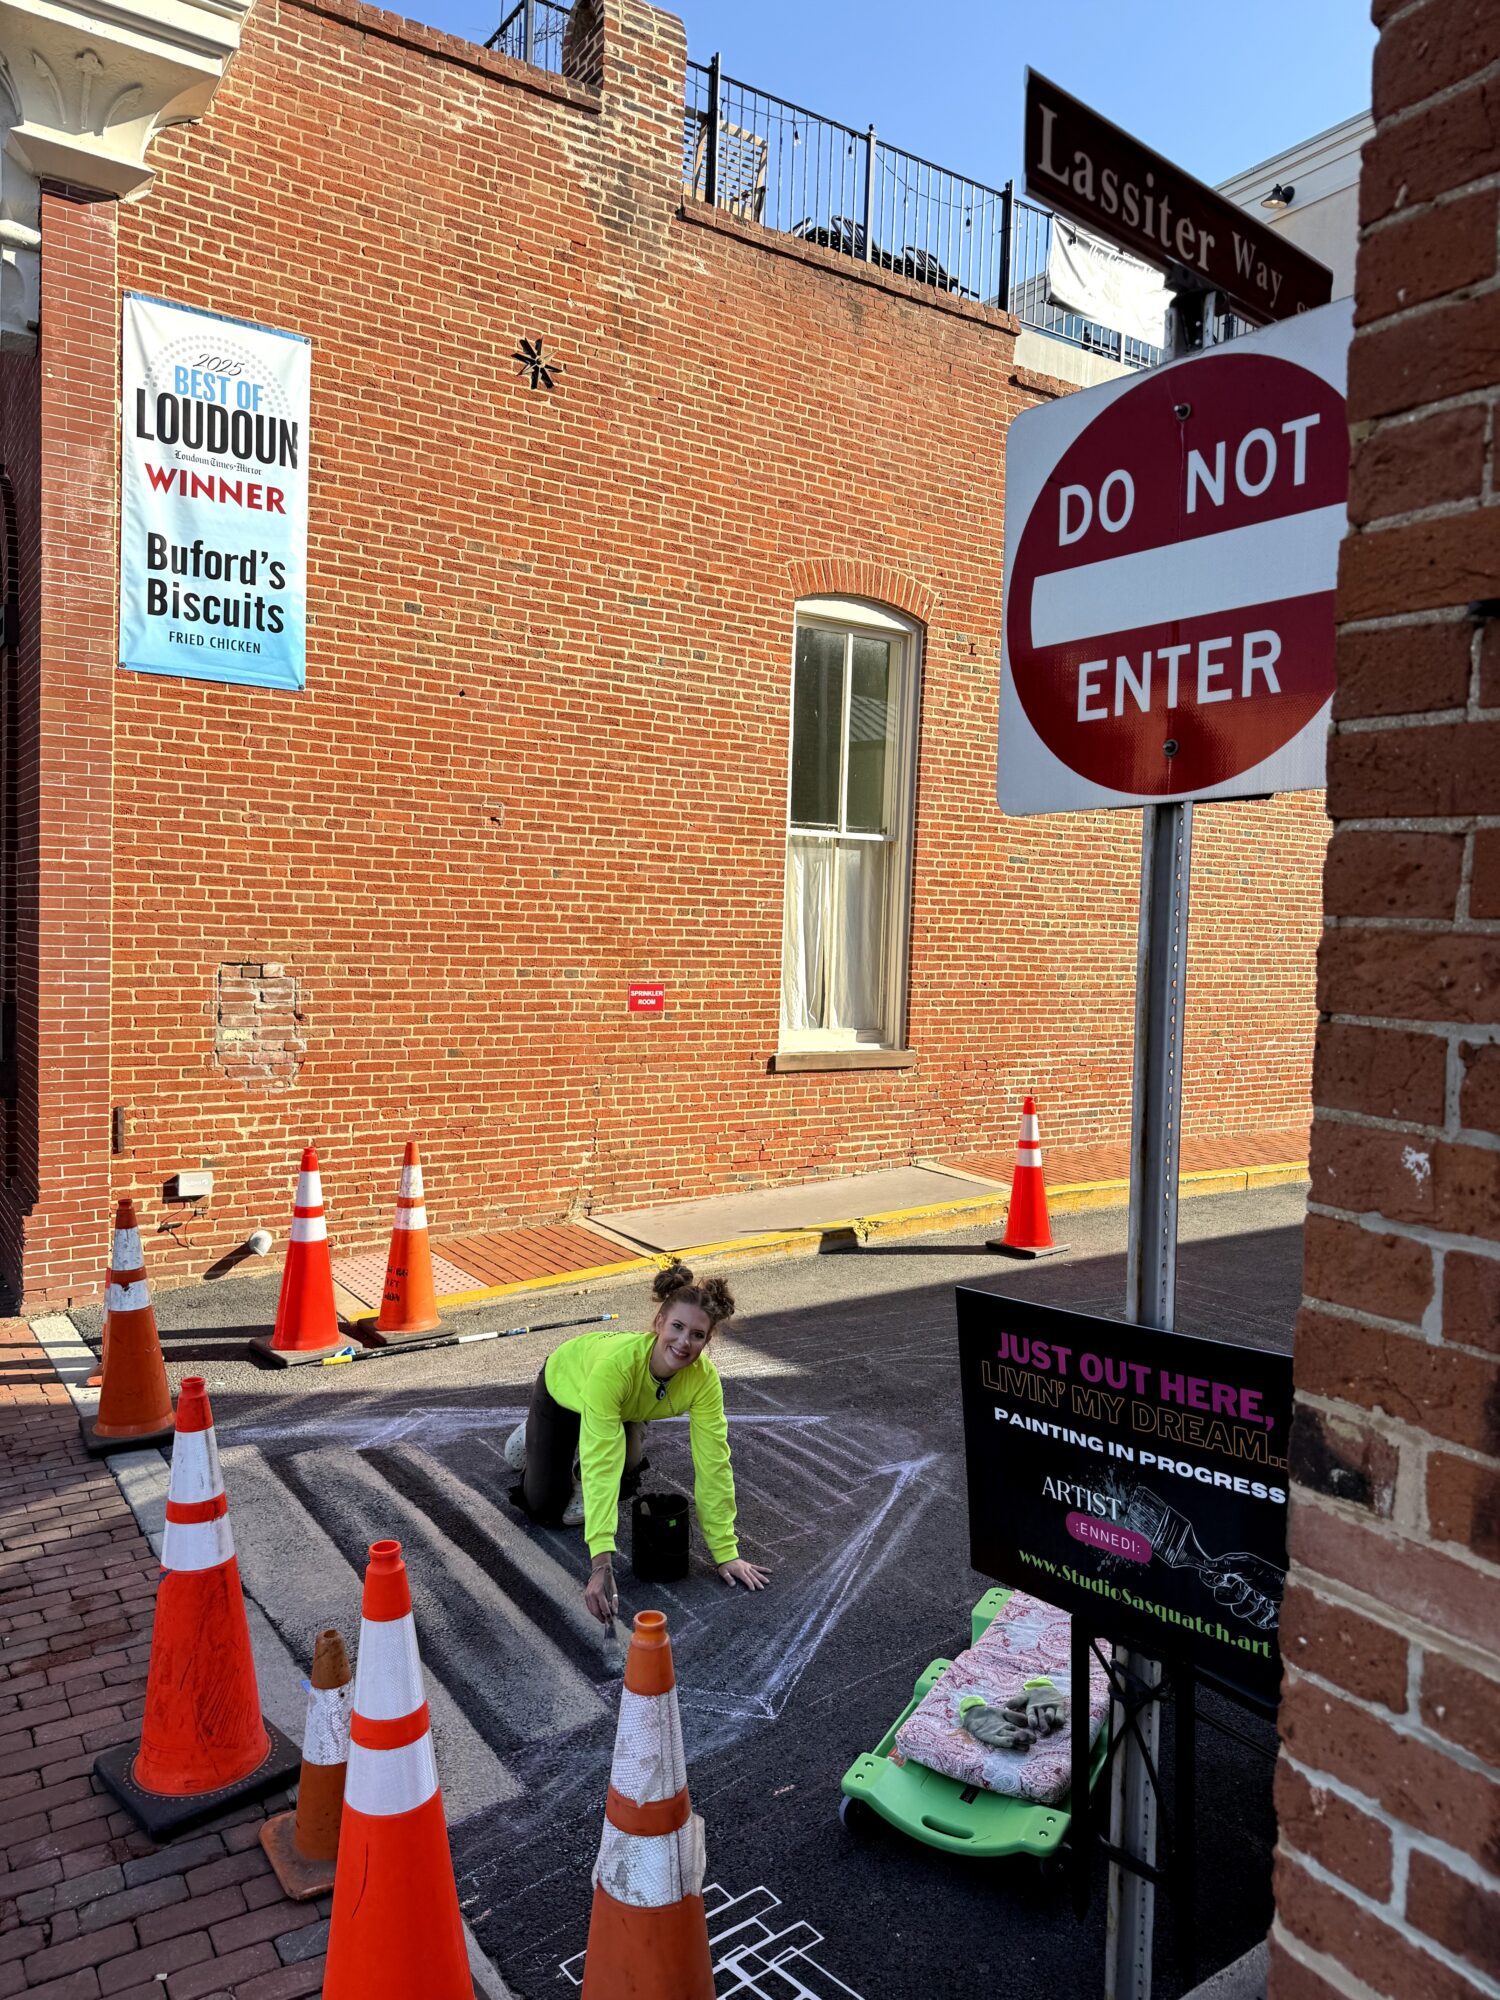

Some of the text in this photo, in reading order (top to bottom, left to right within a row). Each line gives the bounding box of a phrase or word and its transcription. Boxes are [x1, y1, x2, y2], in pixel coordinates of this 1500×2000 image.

[1037, 103, 1283, 308] Lassiter Way
[174, 365, 263, 412] BEST OF
[193, 353, 245, 377] 2025
[136, 388, 298, 470] LOUDOUN
[144, 462, 287, 515] WINNER
[1058, 413, 1321, 547] DO NOT
[146, 578, 285, 634] Biscuits
[168, 630, 262, 655] FRIED CHICKEN
[1076, 629, 1282, 722] ENTER
[997, 1332, 1275, 1431] JUST OUT HERE,
[1072, 1385, 1127, 1425] MY
[994, 1406, 1286, 1505] PAINTING IN PROGRESS
[1042, 1475, 1122, 1521] ARTIST
[1018, 1548, 1273, 1660] www.StudioSasquatch.art
